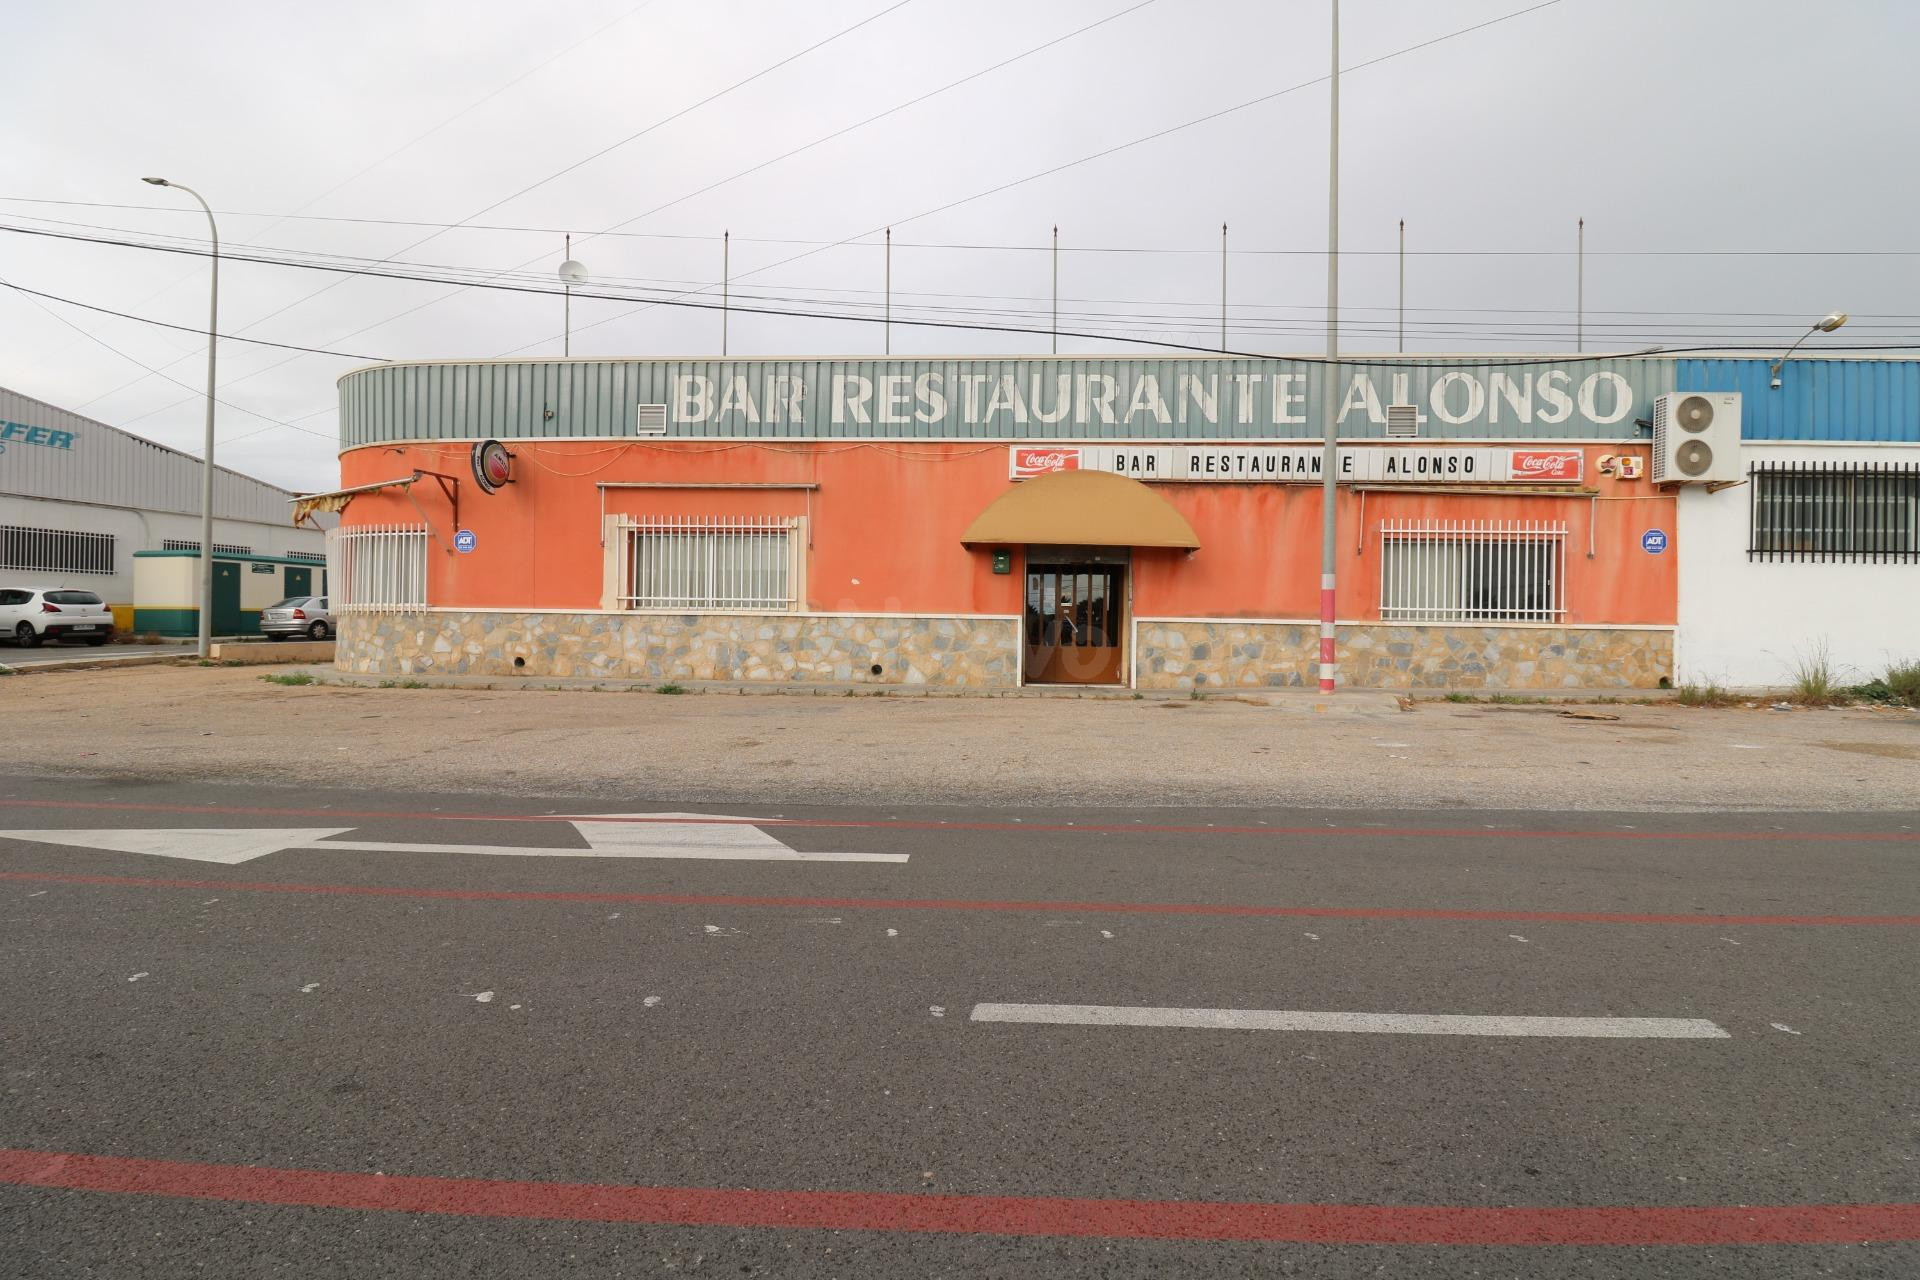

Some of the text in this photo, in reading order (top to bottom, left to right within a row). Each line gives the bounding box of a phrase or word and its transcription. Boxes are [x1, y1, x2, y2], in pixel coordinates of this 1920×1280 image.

[672, 370, 1633, 424] BAR RESTAURANTE ALONSO
[0, 420, 74, 448] FER
[1116, 455, 1474, 474] BAR RESTAURANE ALONSO
[458, 536, 472, 545] ADT
[1646, 536, 1663, 545] ADT
